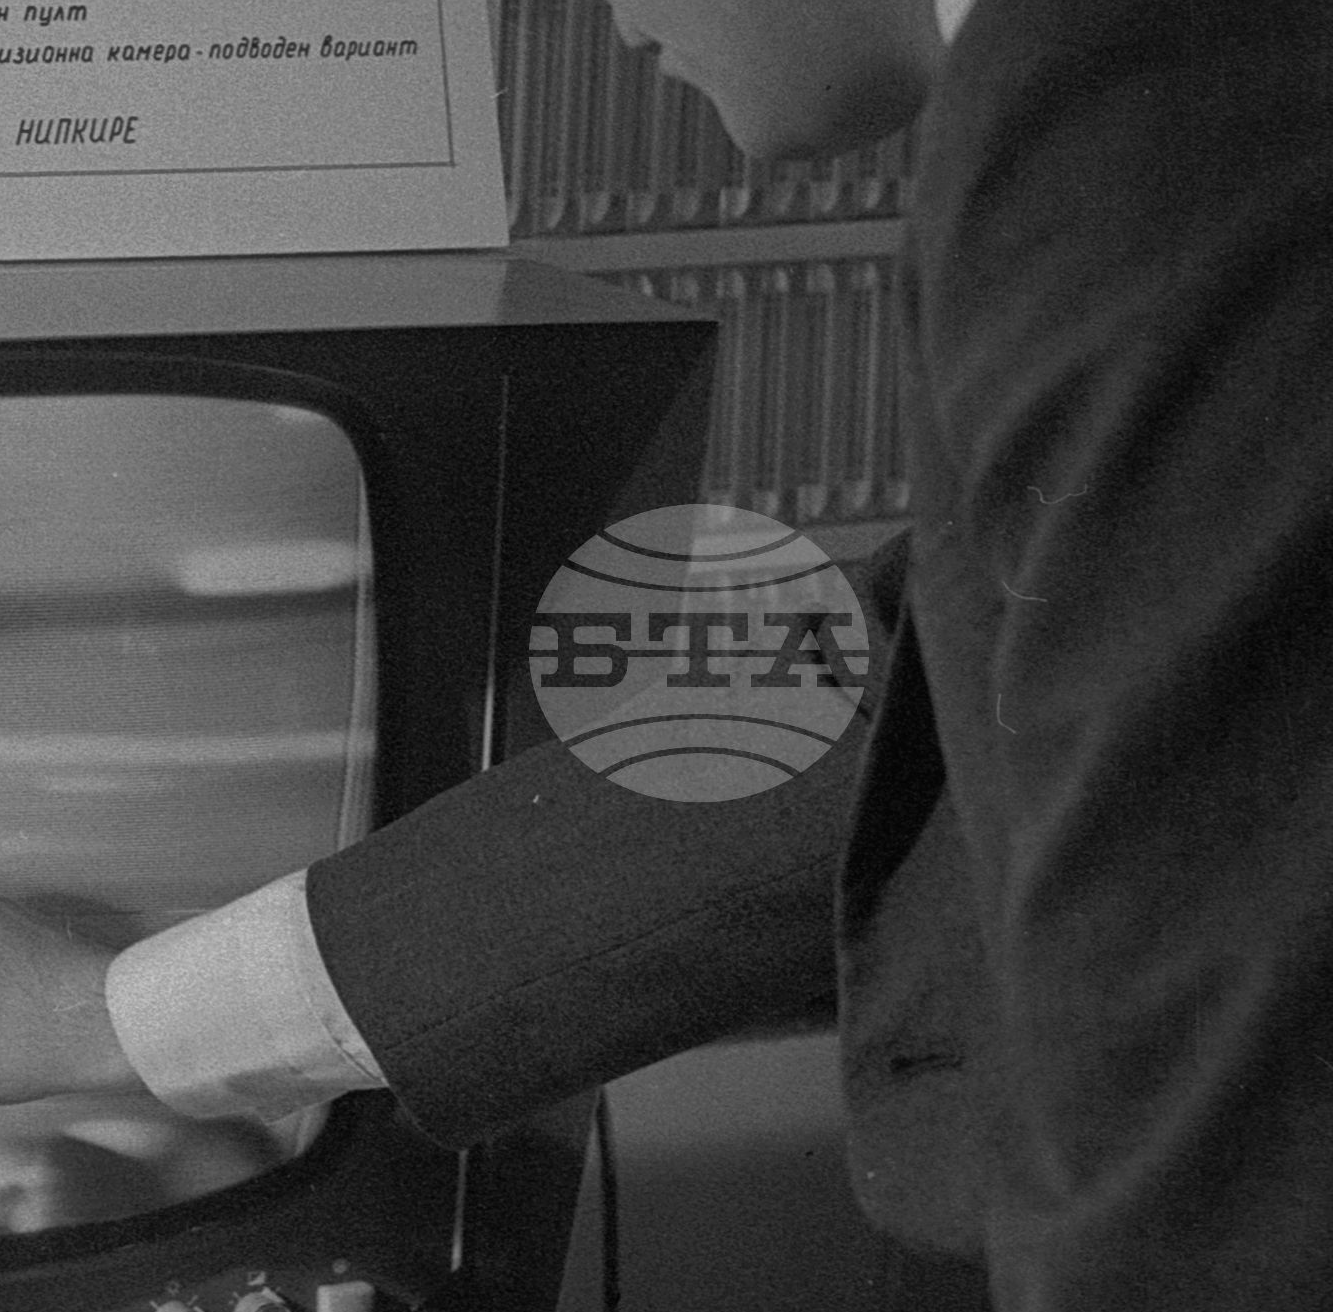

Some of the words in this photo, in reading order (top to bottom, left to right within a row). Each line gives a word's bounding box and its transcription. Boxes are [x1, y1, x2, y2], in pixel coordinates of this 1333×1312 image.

[23, 4, 88, 27] пулт
[319, 33, 420, 62] вариант
[15, 115, 139, 146] НИПКИРЕ
